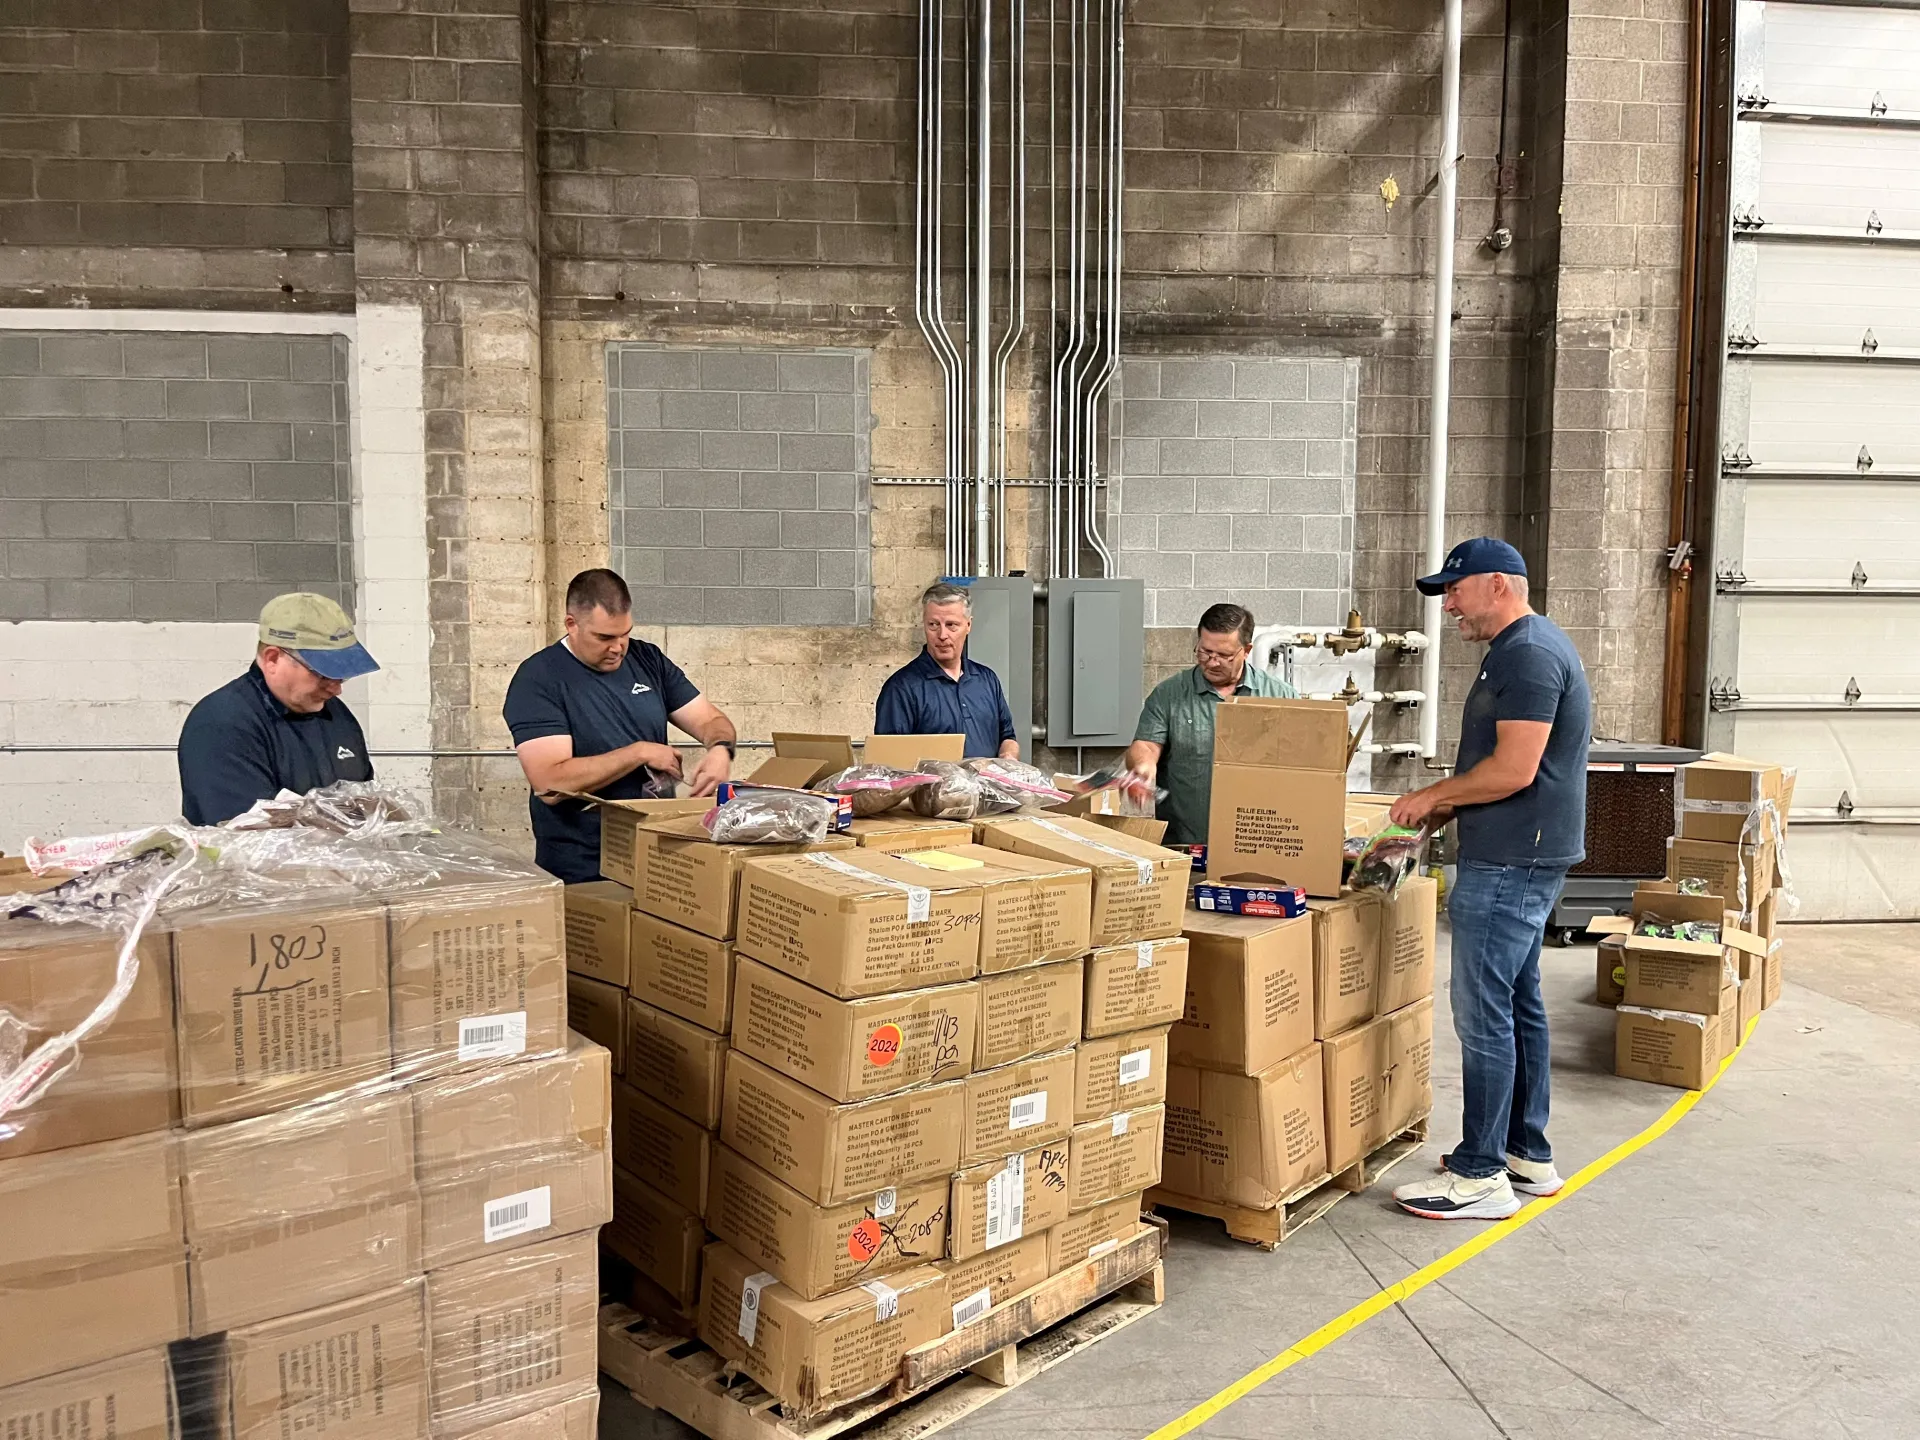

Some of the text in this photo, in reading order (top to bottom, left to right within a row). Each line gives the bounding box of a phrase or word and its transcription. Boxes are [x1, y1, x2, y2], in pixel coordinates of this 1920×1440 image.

[870, 915, 894, 924] MASTER
[989, 992, 1009, 1000] MASTER
[1010, 987, 1030, 996] CARTON
[752, 983, 821, 1018] MASTER CARTON FRONT MARK
[234, 1009, 243, 1024] SIDE
[894, 1014, 916, 1023] CARTON
[235, 1026, 244, 1055] CARTON
[870, 1039, 898, 1053] 2024
[977, 1088, 999, 1098] MASTER
[1000, 1082, 1020, 1092] CARTON
[1034, 1076, 1048, 1084] MARK
[977, 1100, 996, 1108] Shalom
[849, 1120, 876, 1131] MASTER
[875, 1114, 900, 1125] CARTON
[901, 1111, 914, 1119] SIDE
[848, 1134, 869, 1142] Shalom
[847, 1142, 869, 1151] Shalom
[845, 1164, 862, 1172] Gross
[853, 1228, 877, 1254] 2024
[952, 1267, 973, 1280] MASTER
[974, 1260, 994, 1271] CARTON
[835, 1329, 859, 1343] MASTER
[899, 1308, 915, 1318] MARK
[834, 1341, 855, 1353] Shalom
[833, 1351, 854, 1362] Shalom
